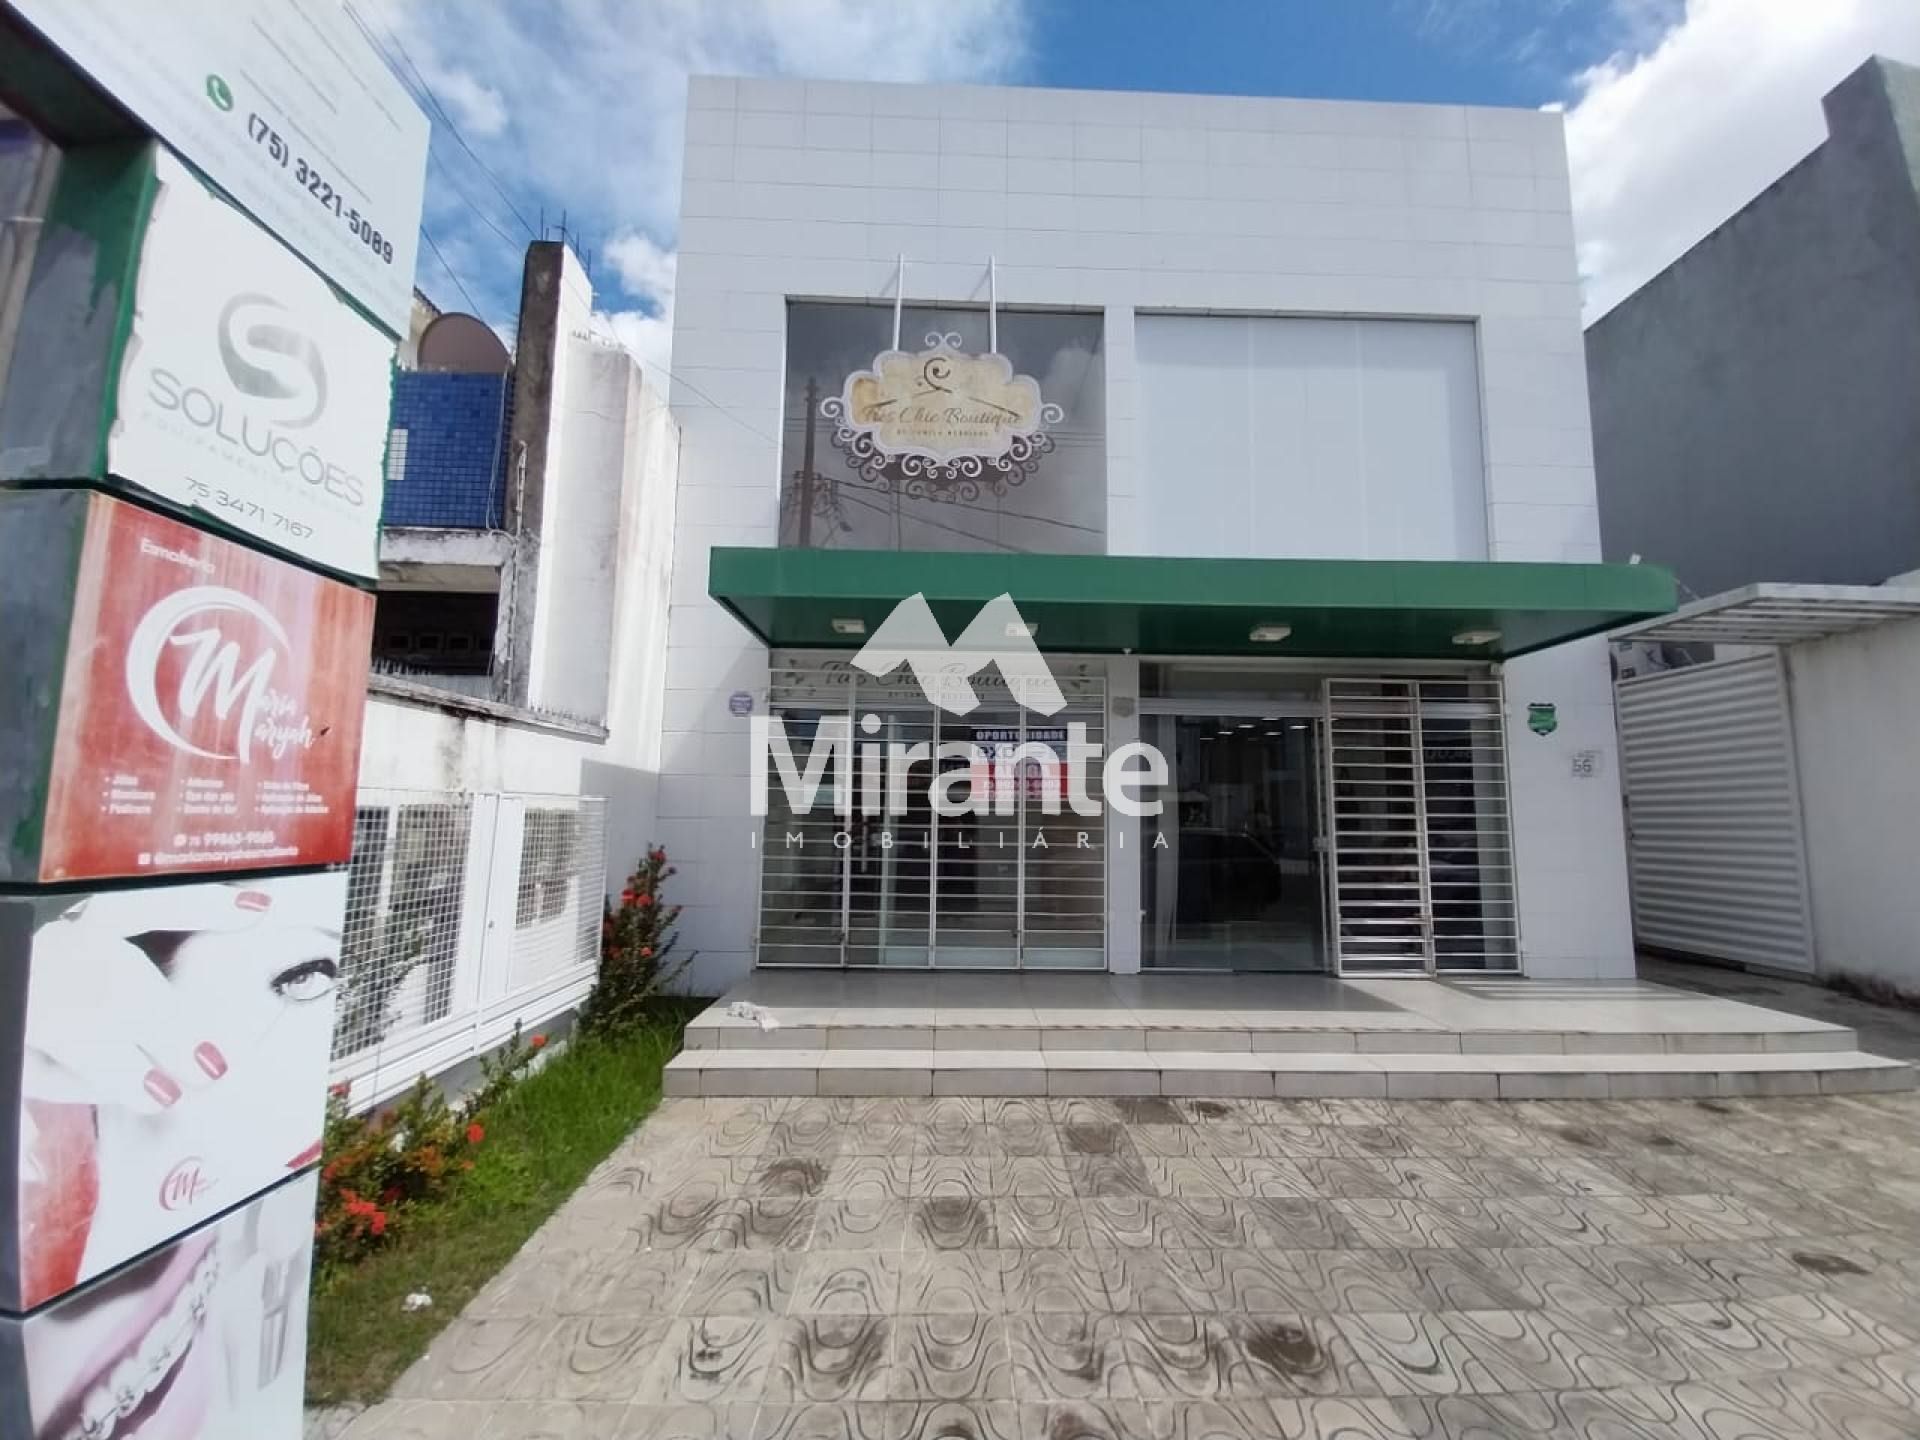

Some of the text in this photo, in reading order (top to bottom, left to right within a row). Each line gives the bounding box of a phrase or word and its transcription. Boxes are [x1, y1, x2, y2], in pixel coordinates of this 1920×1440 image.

[248, 112, 394, 265] (75) 3221-5089
[147, 368, 365, 508] SOLUÇÕES
[184, 475, 211, 499] 75
[216, 489, 266, 522] 3471
